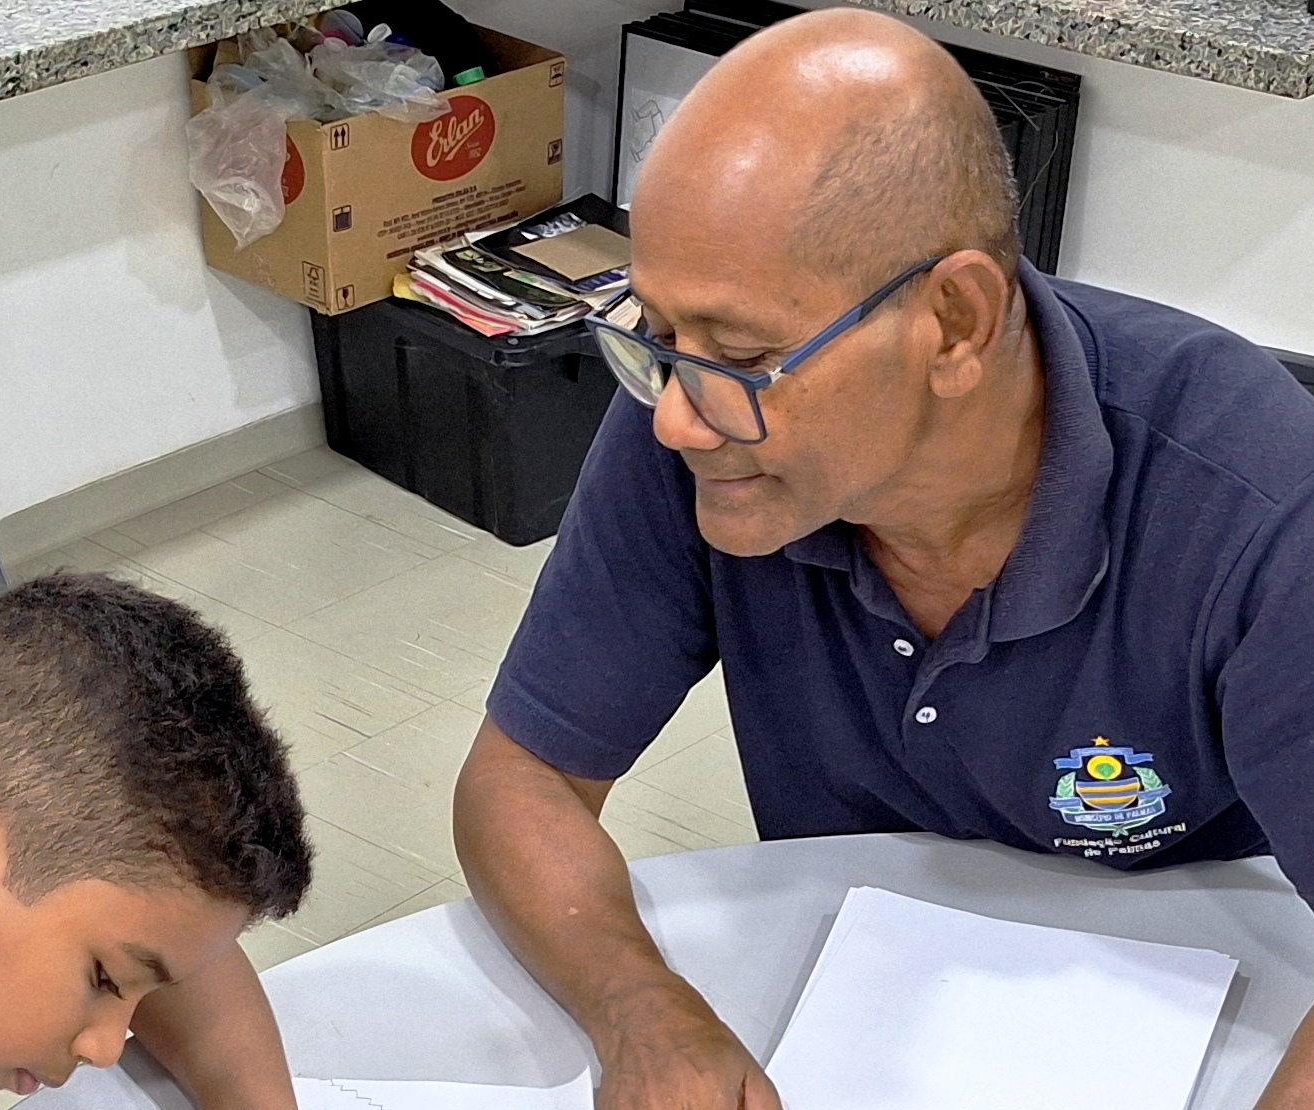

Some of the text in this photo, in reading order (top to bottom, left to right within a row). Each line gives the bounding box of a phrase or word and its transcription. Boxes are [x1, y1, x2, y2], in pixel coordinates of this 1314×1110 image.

[426, 108, 485, 168] Erlan
[1129, 822, 1186, 843] Cultural
[1108, 840, 1161, 856] Palmas
